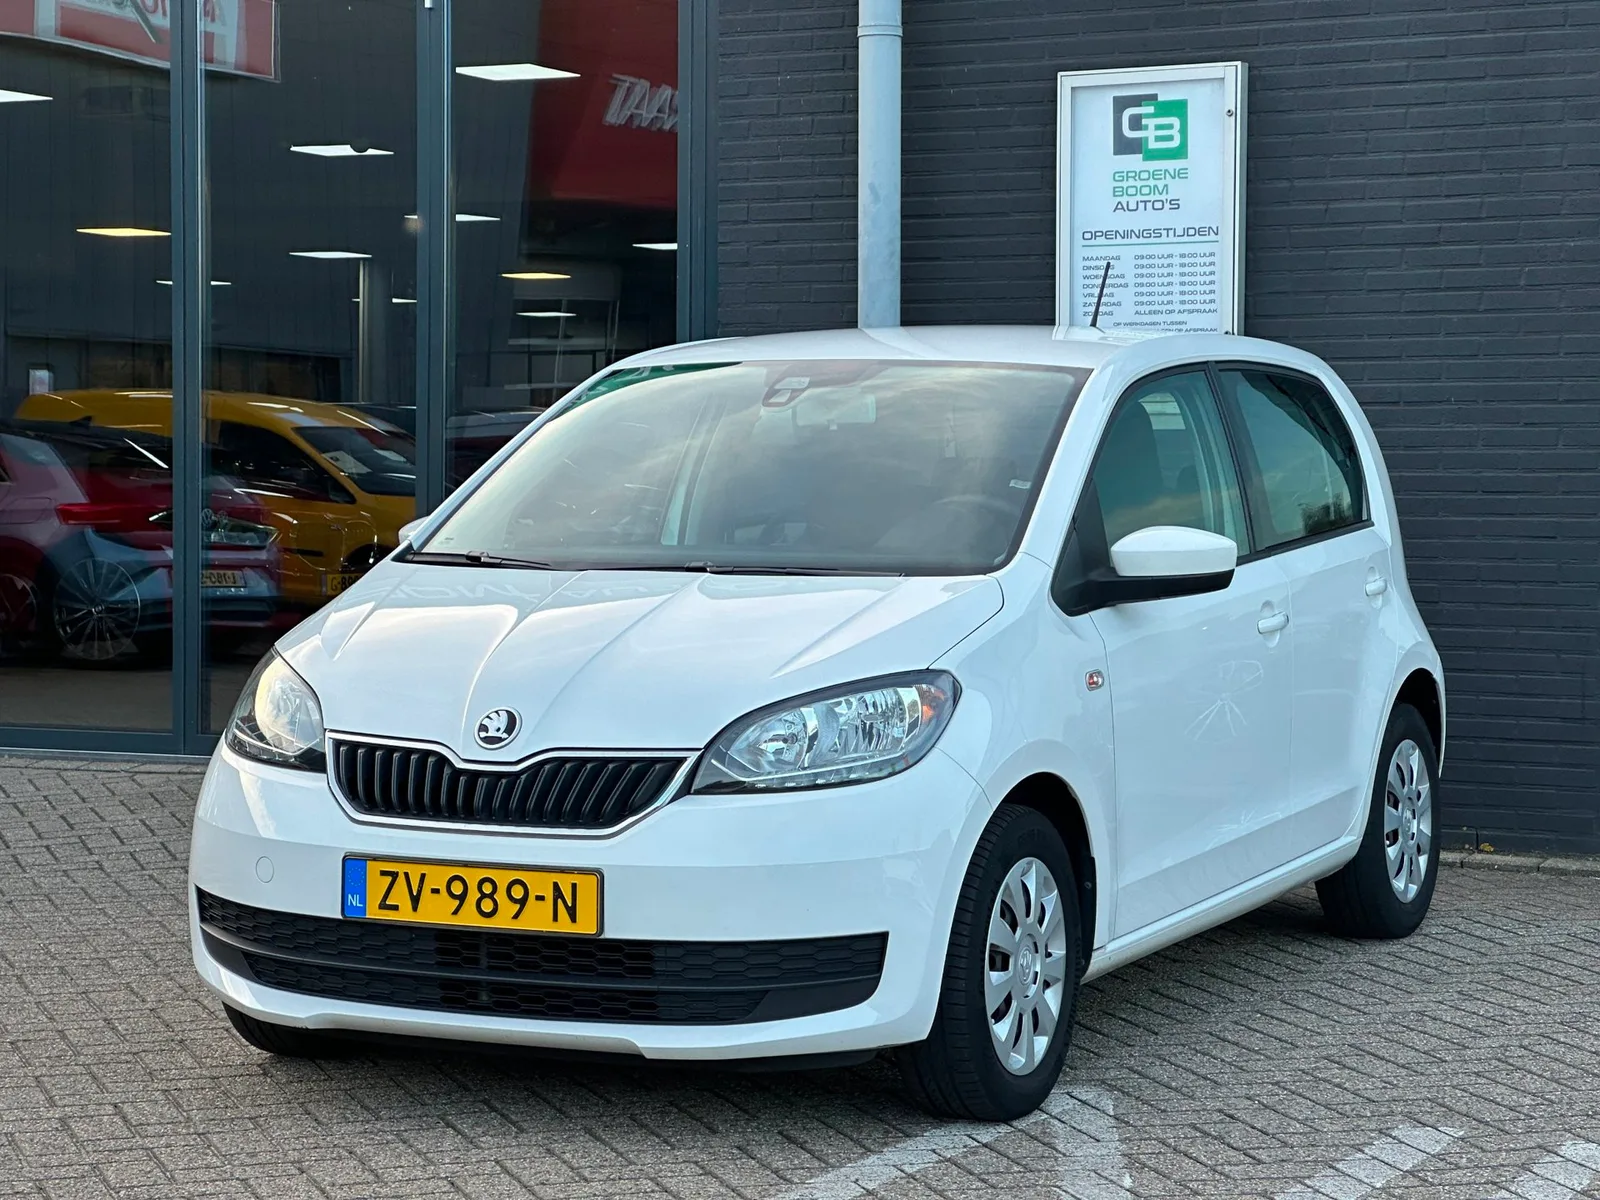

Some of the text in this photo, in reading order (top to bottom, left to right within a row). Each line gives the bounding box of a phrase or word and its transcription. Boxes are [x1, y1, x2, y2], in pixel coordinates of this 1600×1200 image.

[1113, 168, 1188, 182] GROENE
[1113, 184, 1168, 197] BOOM
[1113, 199, 1180, 212] AUTO'S
[1082, 226, 1219, 241] OPENINGSTIJDEN
[348, 894, 363, 906] NL
[378, 869, 578, 924] ZV-989-N
